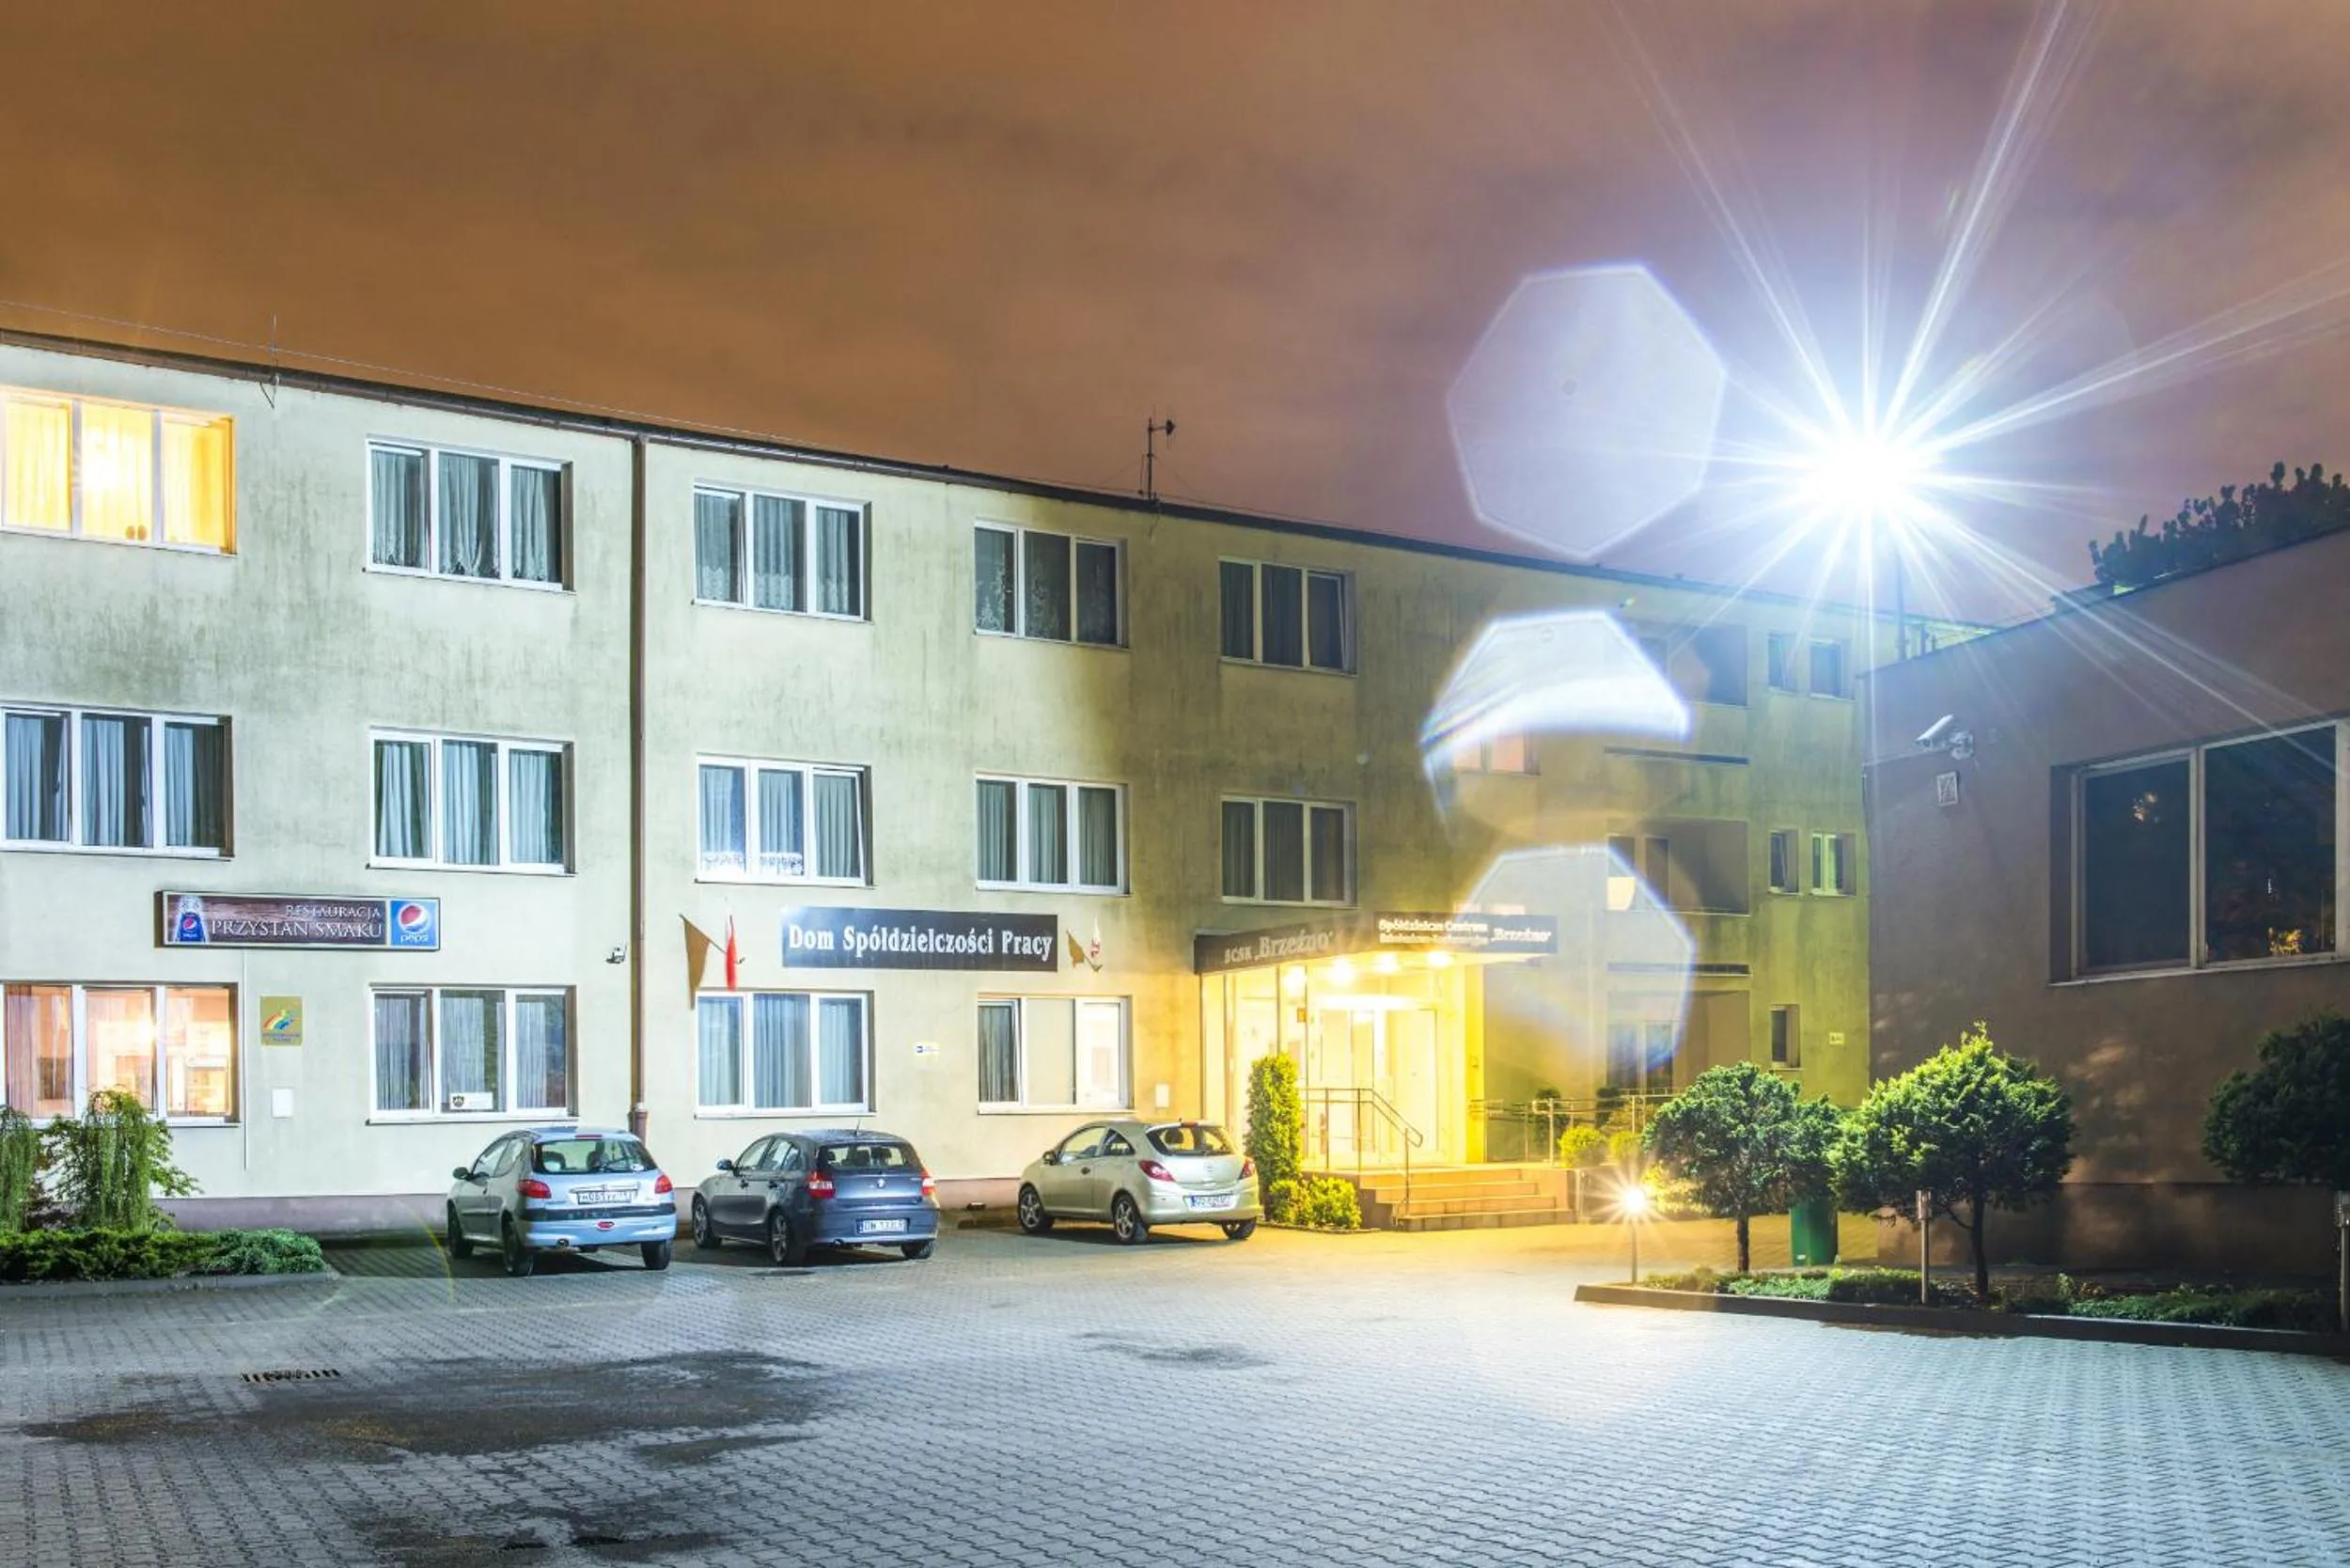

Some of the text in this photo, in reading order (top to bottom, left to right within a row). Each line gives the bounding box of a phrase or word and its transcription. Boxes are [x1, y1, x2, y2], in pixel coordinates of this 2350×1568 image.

[286, 904, 382, 920] RESTAURACJA
[316, 922, 382, 938] SMAKU
[789, 924, 1053, 962] Dom Spółdzielczości Pracy
